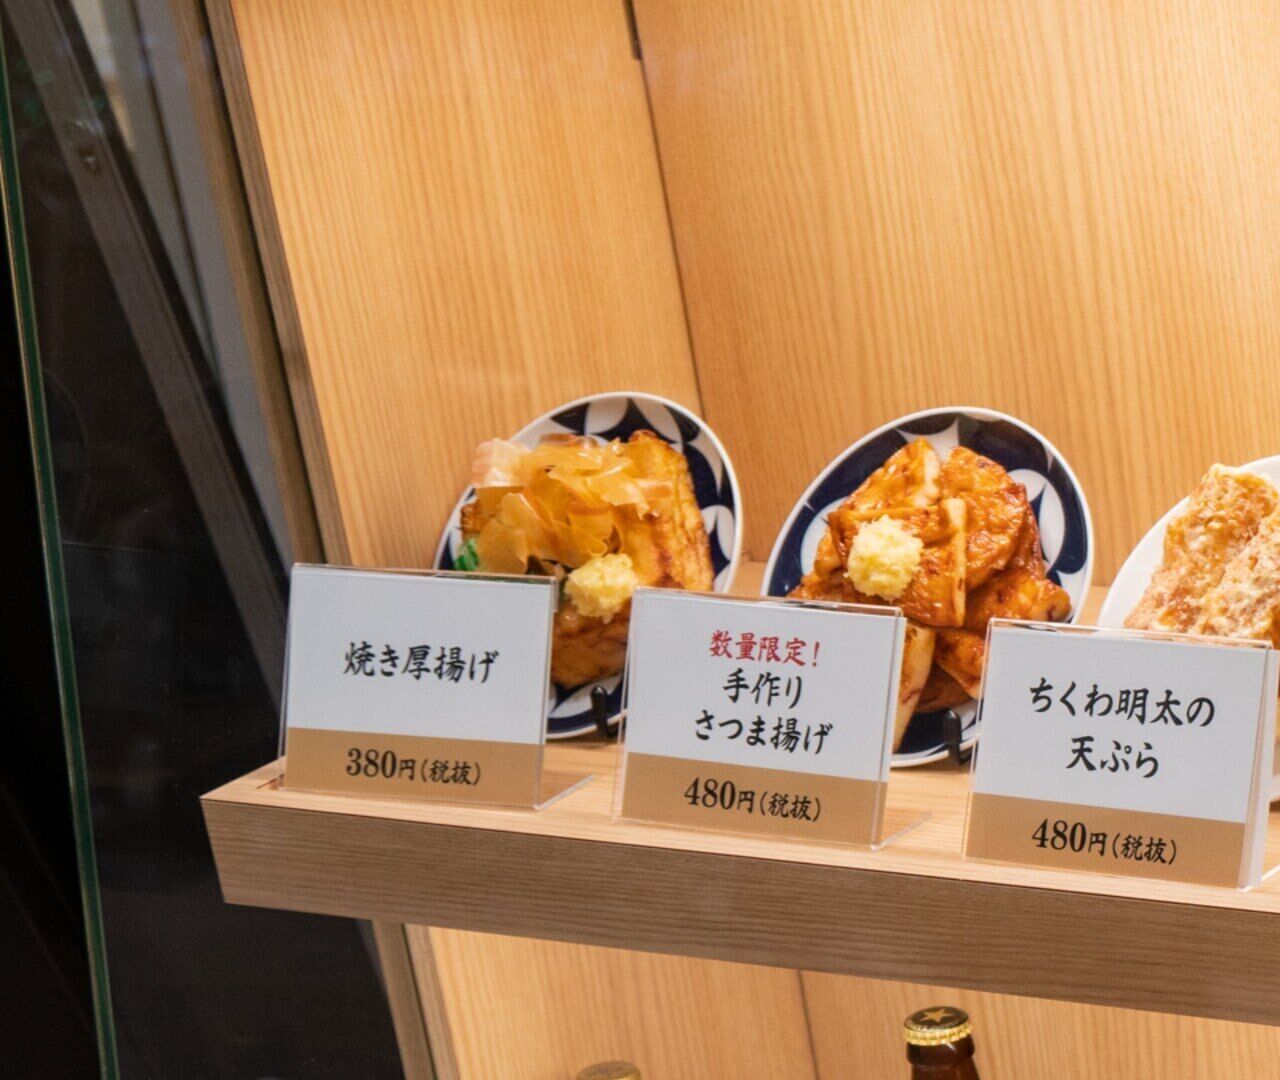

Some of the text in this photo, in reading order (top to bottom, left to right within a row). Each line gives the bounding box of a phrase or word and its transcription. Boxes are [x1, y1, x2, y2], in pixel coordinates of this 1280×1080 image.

[342, 641, 500, 685] 焼き厚揚げ
[709, 630, 821, 668] 数量限定！
[722, 669, 803, 710] 手作り
[1029, 677, 1216, 728] ちくわ明太の
[694, 708, 834, 755] さつま揚げ
[345, 747, 481, 786] 380円（税抜）
[1066, 735, 1160, 778] 天ぷら
[683, 777, 821, 824] 480円（税抜）
[1031, 818, 1177, 865] 480円（税抜）
